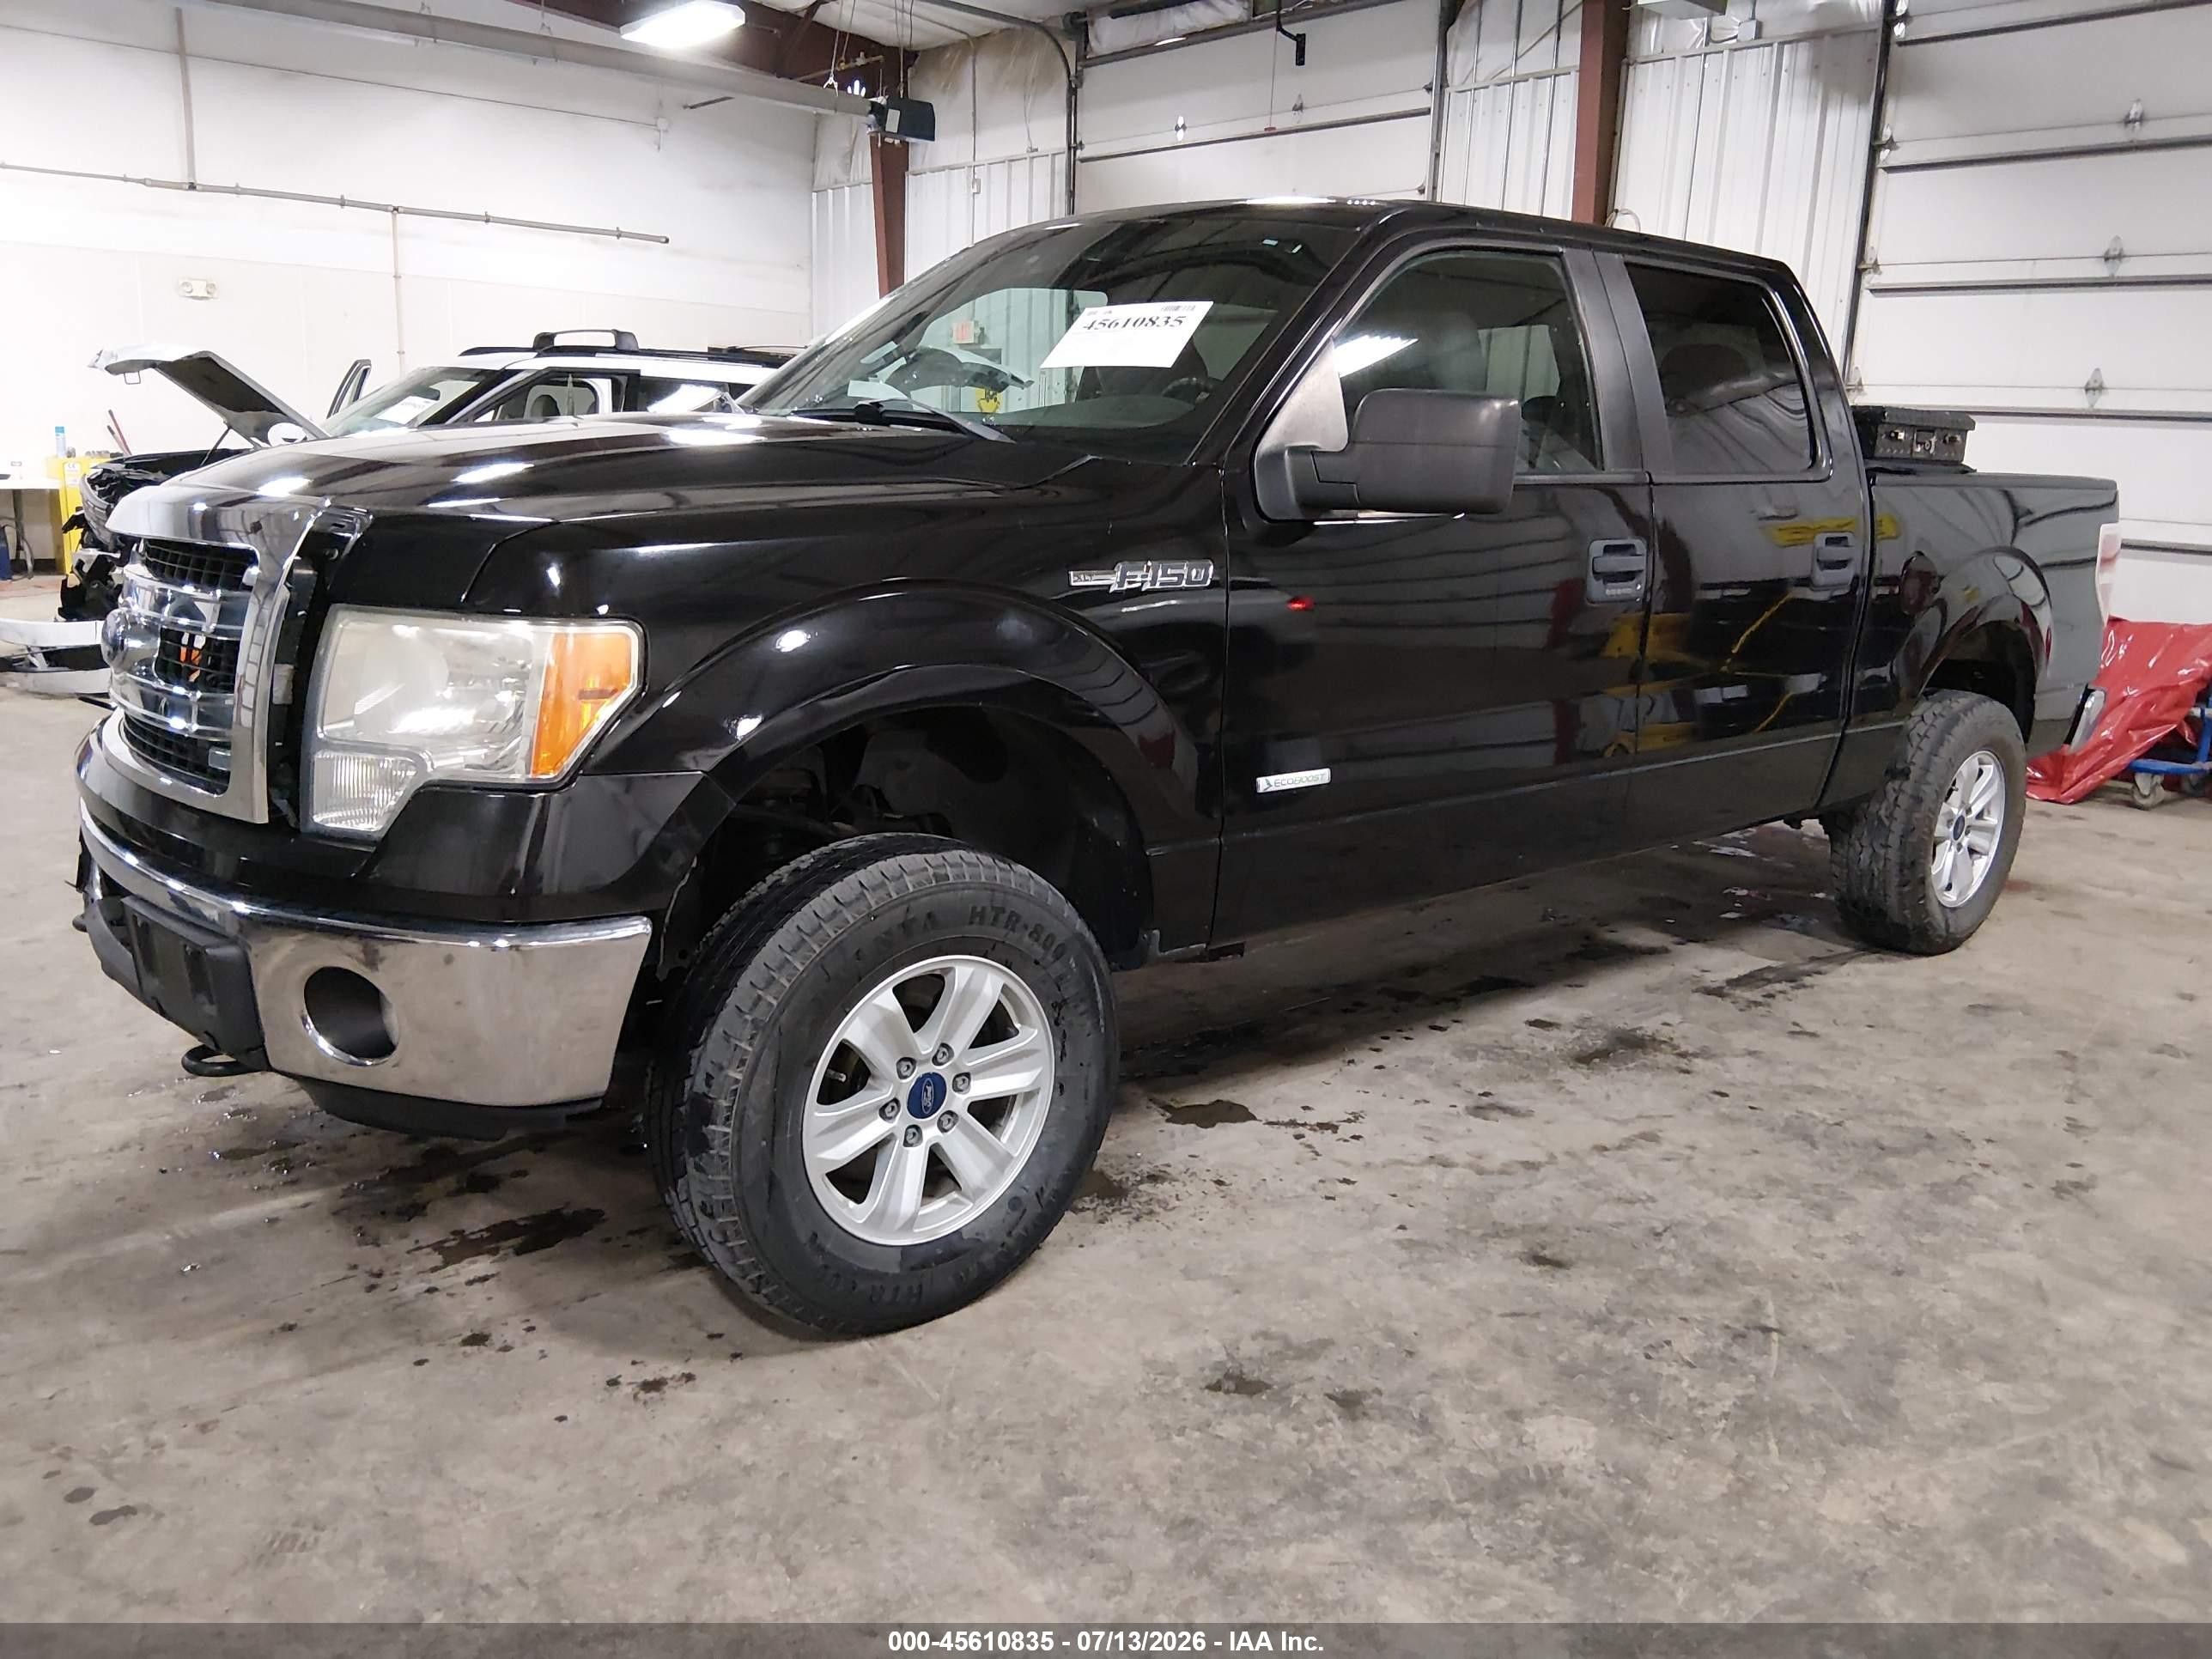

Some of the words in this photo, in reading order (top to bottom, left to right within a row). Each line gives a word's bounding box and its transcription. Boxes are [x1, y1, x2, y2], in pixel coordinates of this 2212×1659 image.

[1083, 315, 1187, 331] 45610835
[1109, 560, 1214, 593] F-150
[1273, 774, 1326, 787] ECOBOOST
